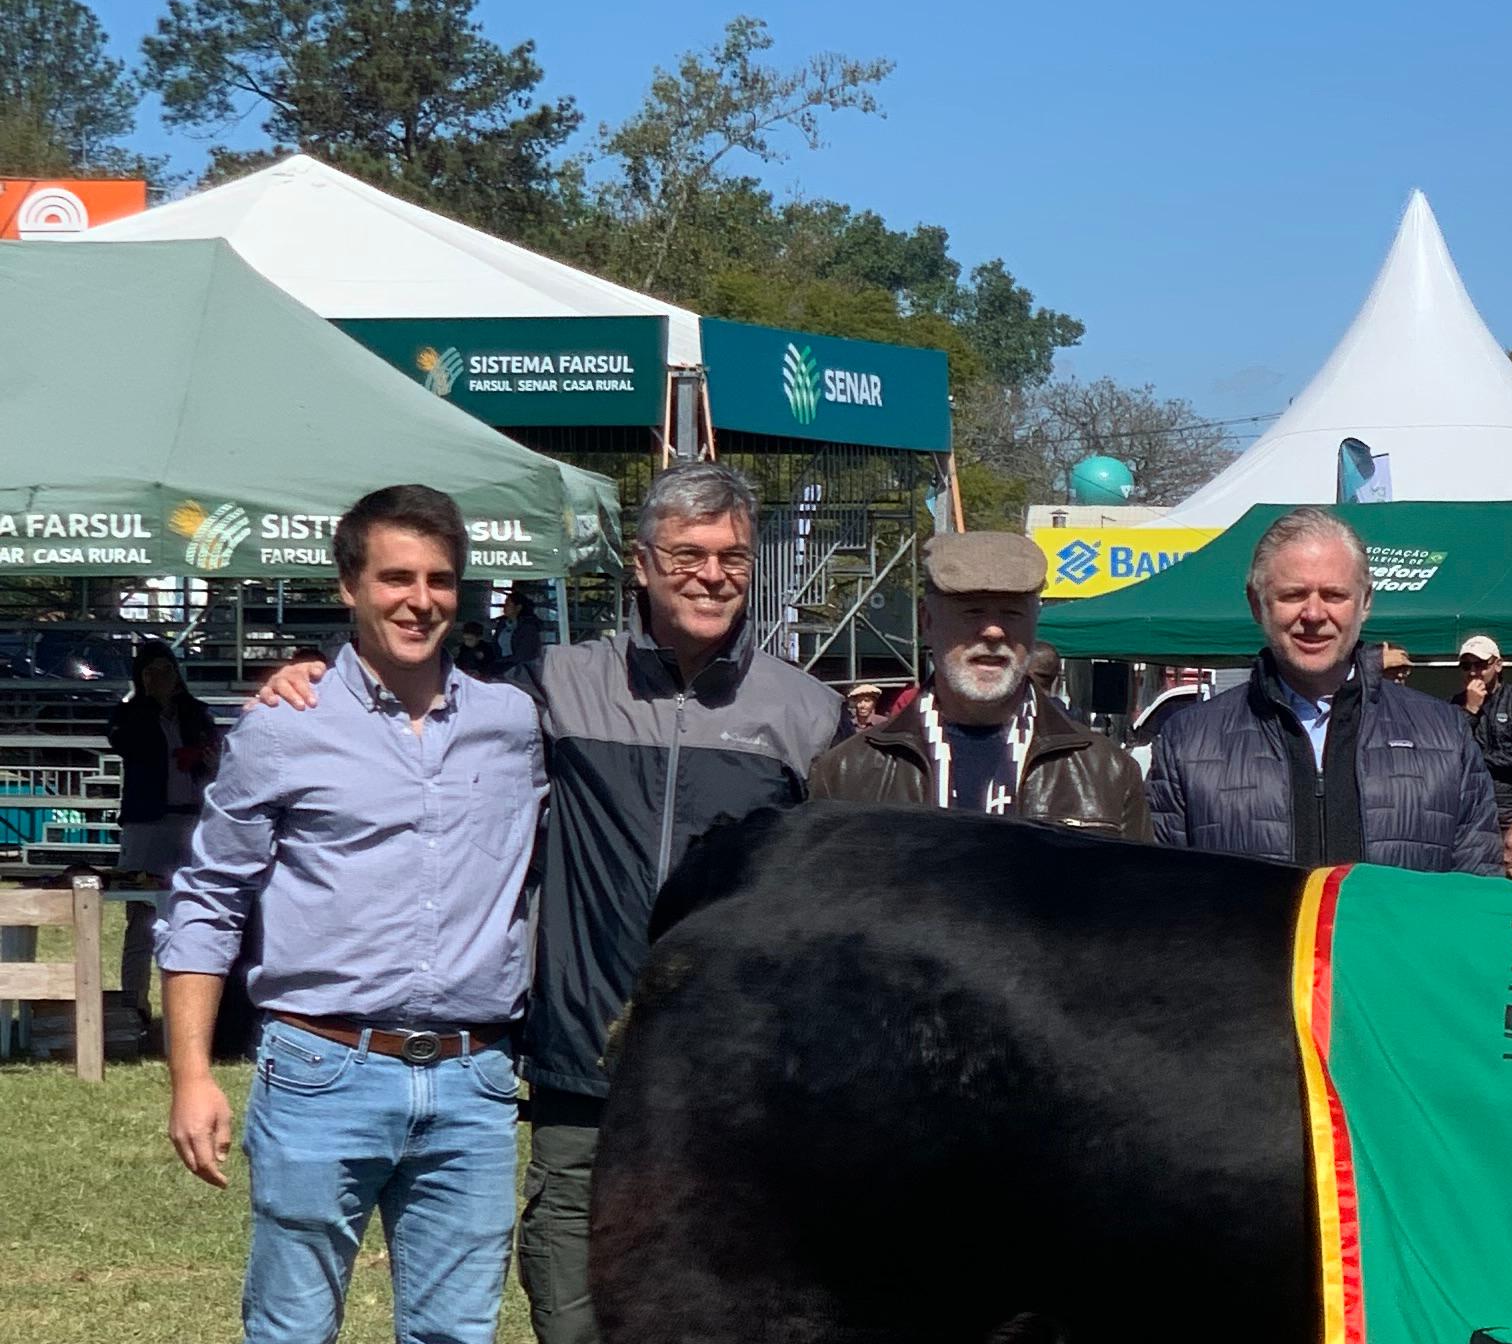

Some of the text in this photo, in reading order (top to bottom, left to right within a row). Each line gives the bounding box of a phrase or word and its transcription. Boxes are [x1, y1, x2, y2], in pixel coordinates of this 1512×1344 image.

[469, 355, 635, 374] SISTEMA FARSUL
[469, 379, 635, 392] FARSUL SENAR CASA RURAL
[824, 368, 883, 407] SENAR
[26, 512, 152, 538] FARSUL
[465, 519, 532, 542] SUL
[33, 547, 85, 564] CASA
[88, 547, 152, 564] RURAL
[260, 548, 333, 565] FARSUL
[471, 550, 534, 566] RURAL
